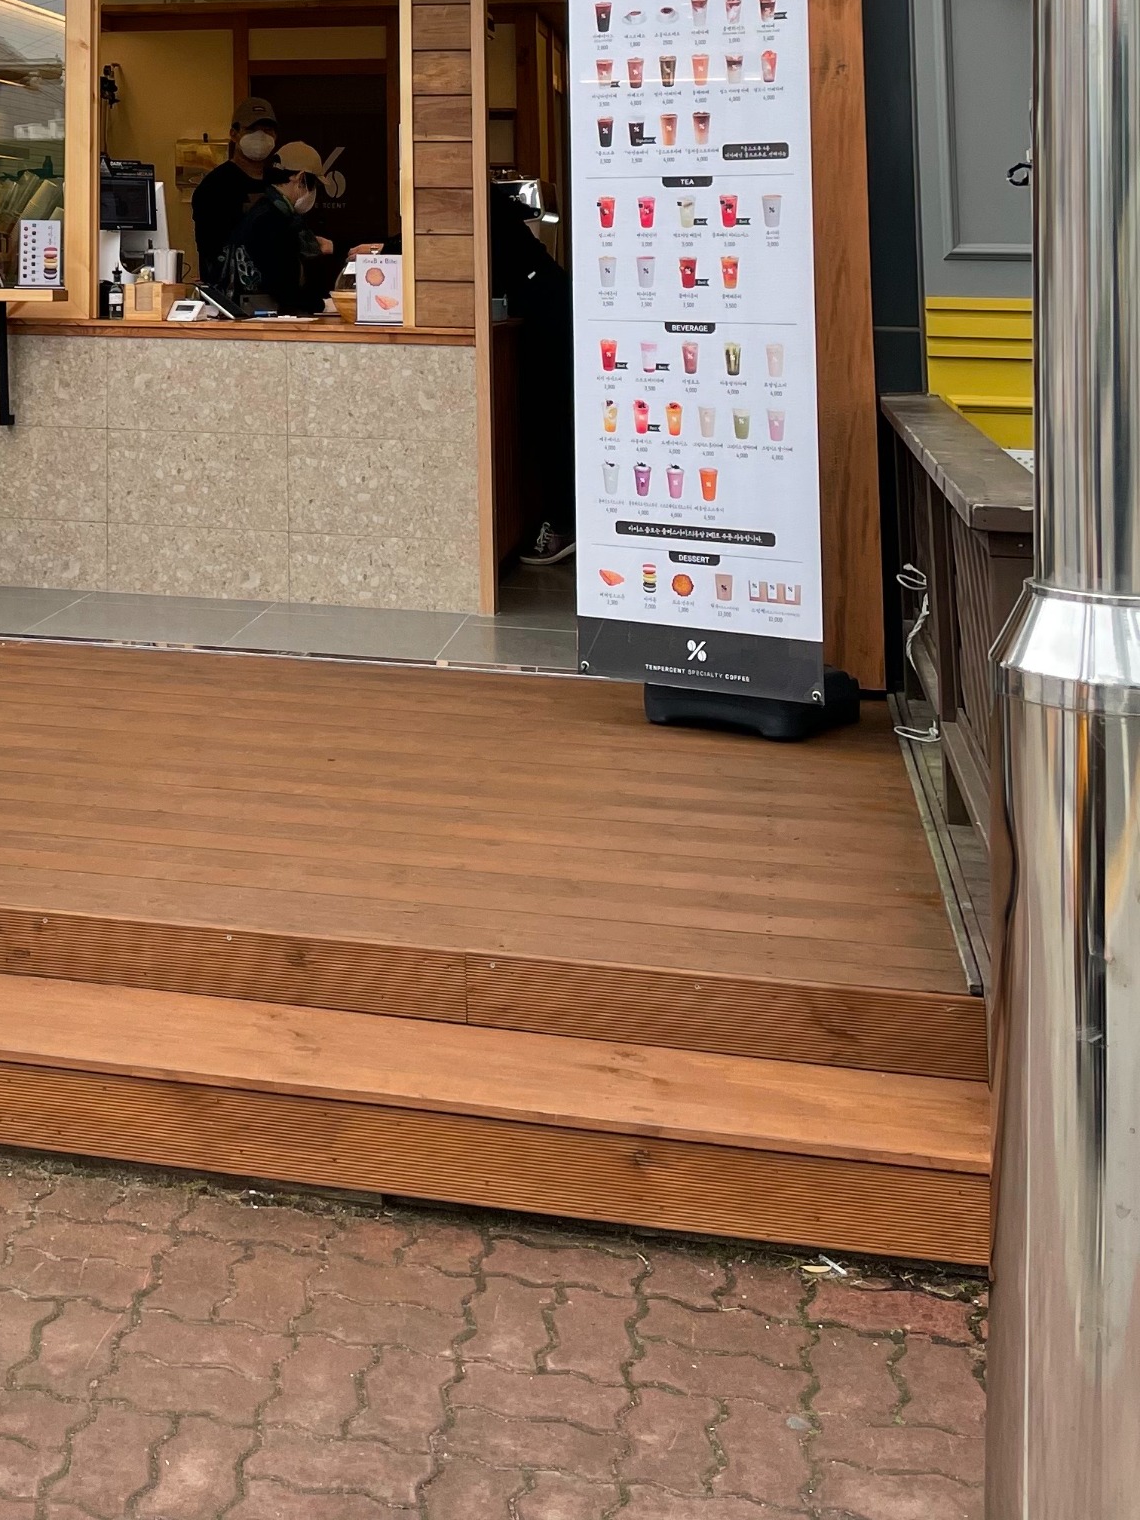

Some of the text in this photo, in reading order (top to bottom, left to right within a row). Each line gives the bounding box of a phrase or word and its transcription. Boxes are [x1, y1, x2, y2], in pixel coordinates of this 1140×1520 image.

[680, 178, 695, 186] TEA
[671, 324, 709, 332] BEVERAGE
[678, 554, 710, 564] DESSERT
[687, 669, 723, 679] SPECIALTY
